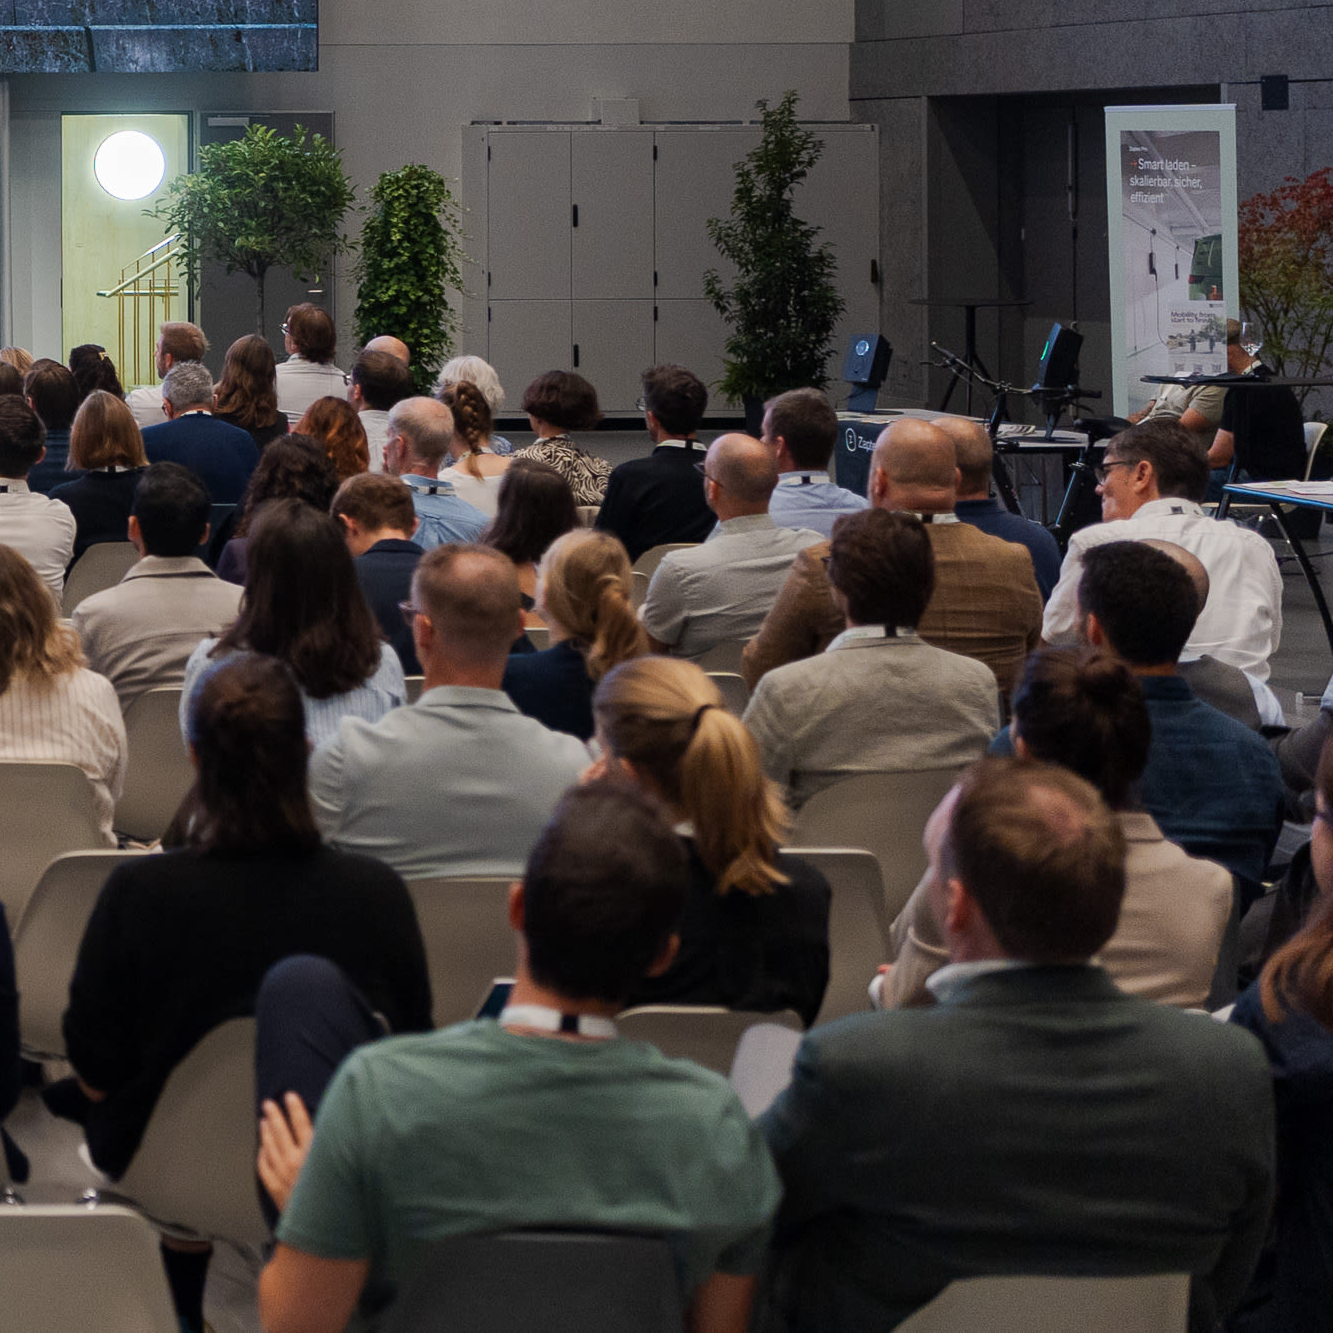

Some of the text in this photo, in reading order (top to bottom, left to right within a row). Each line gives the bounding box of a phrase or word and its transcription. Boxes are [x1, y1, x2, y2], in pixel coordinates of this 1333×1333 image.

[1138, 157, 1164, 171] Smart
[1165, 158, 1189, 171] laden
[1130, 192, 1164, 204] effizient
[857, 436, 877, 452] Zapte
